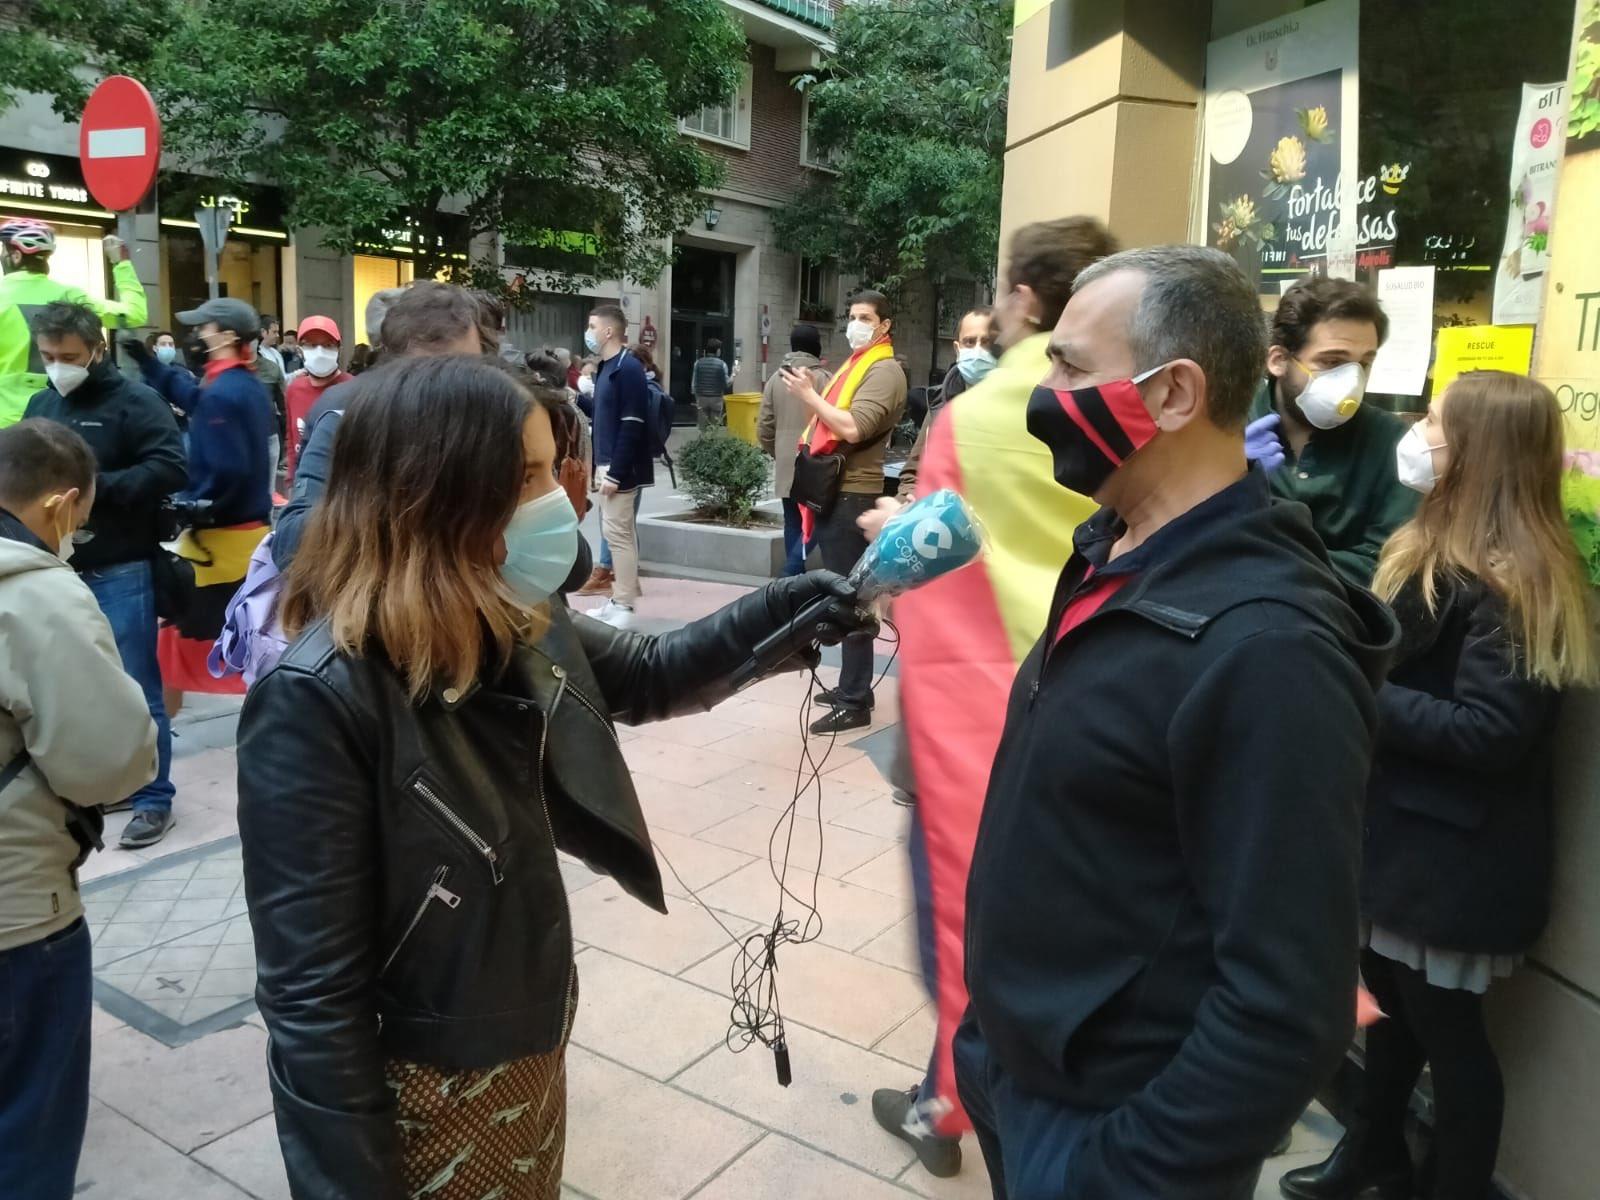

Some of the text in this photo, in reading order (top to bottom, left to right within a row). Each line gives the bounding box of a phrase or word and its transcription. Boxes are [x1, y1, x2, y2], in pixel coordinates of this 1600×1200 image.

[1288, 170, 1377, 219] fortalce
[1286, 210, 1397, 251] tus defsas
[1575, 291, 1600, 351] T
[1466, 340, 1496, 350] RESCUE
[1555, 384, 1600, 421] Org
[894, 536, 924, 573] COPE
